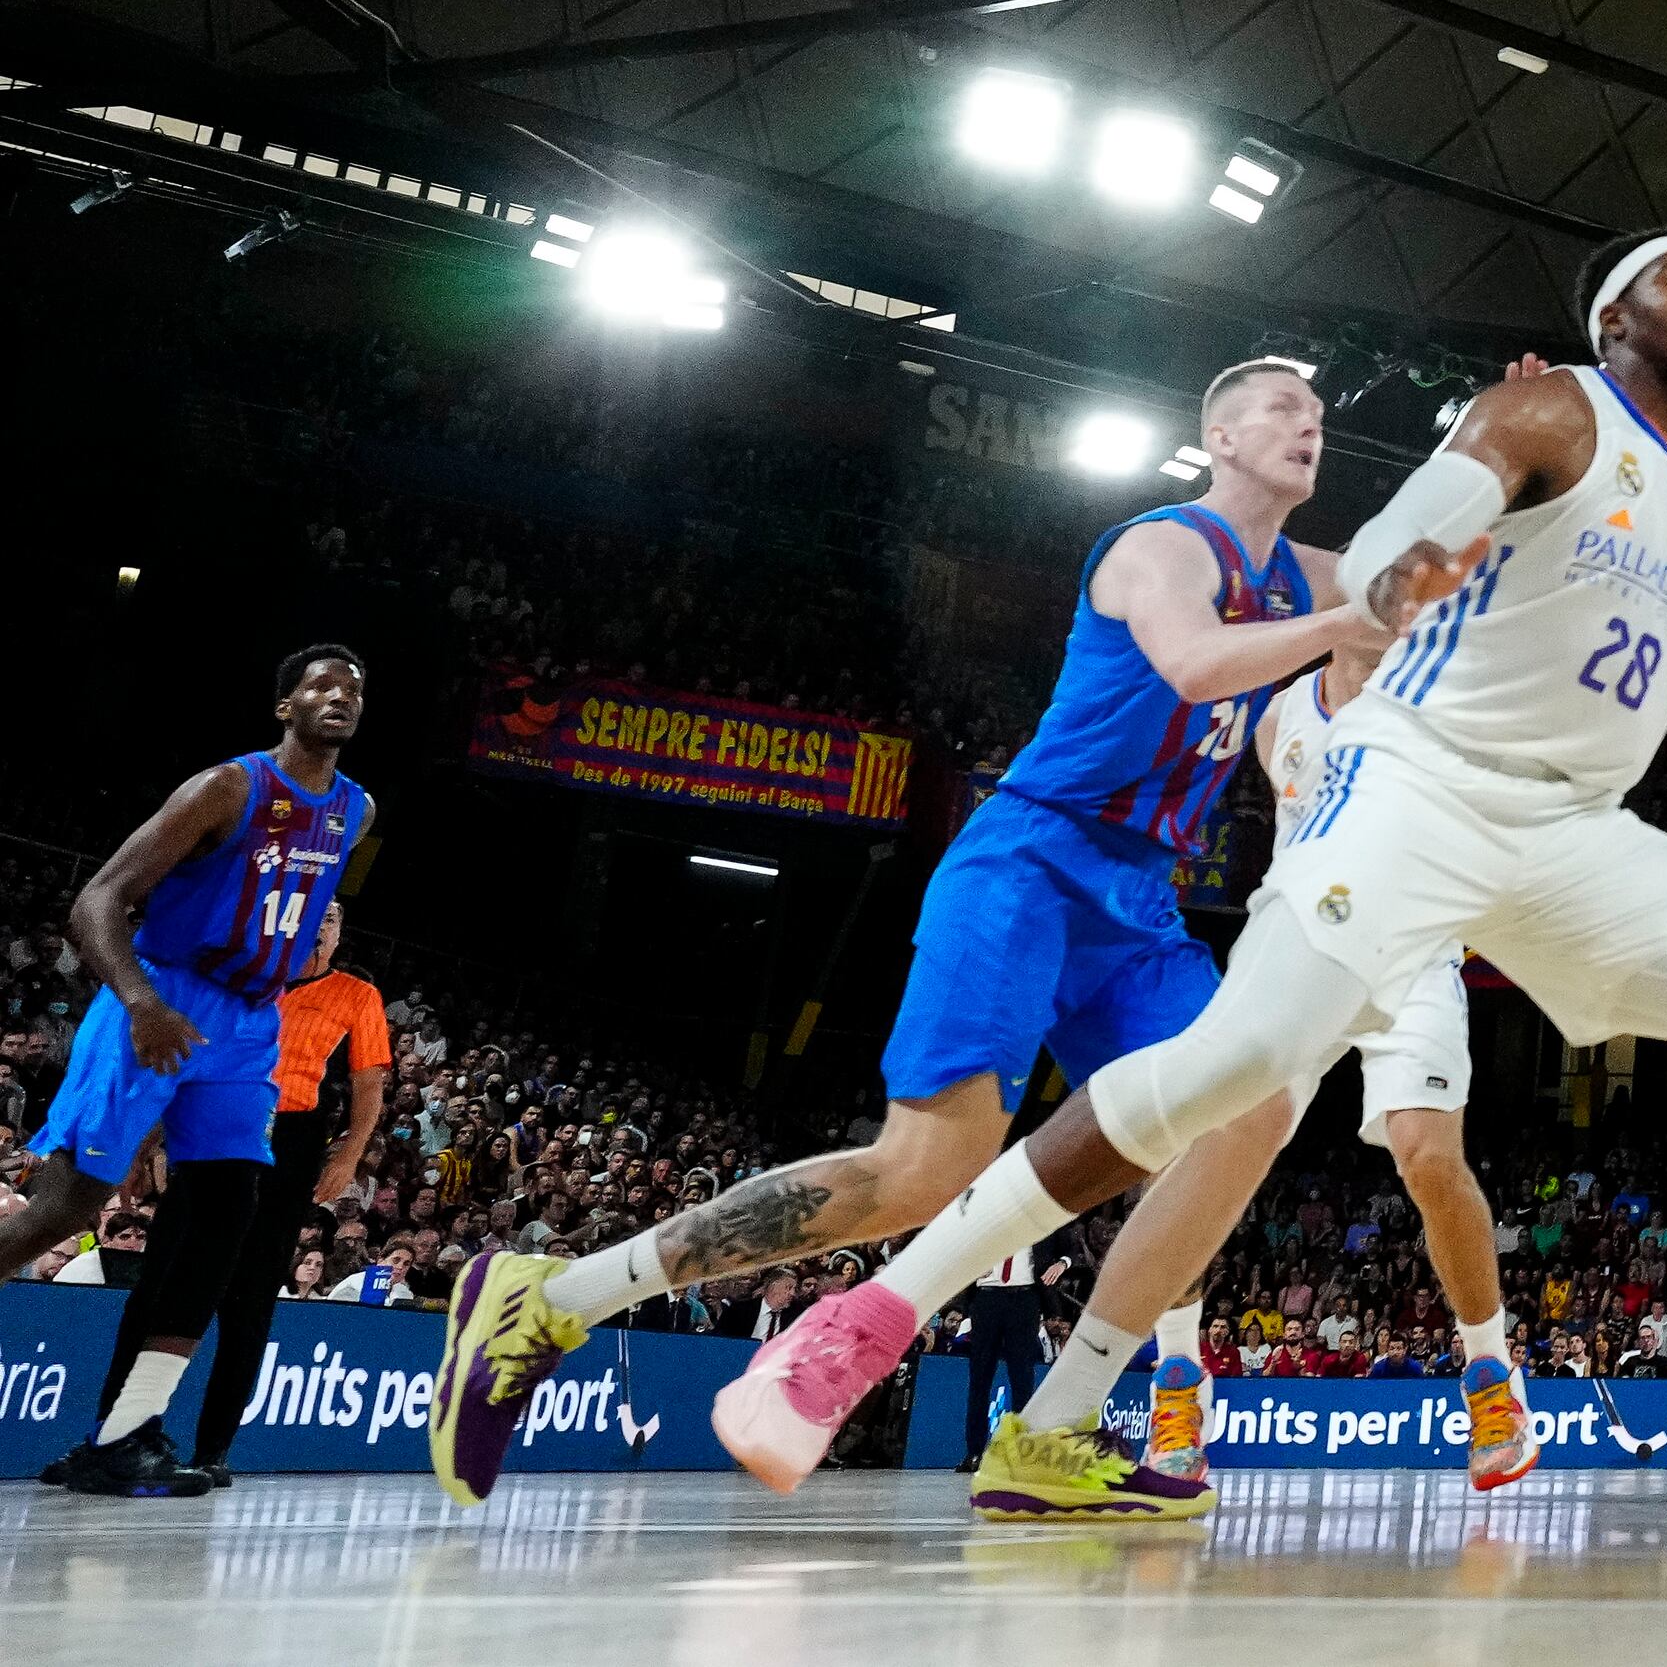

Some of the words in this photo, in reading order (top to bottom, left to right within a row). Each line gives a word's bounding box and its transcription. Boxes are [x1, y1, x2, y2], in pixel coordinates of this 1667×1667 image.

[1578, 616, 1662, 712] 28
[575, 697, 710, 762] SEMPRE
[716, 717, 833, 778] FIDELS!
[572, 760, 603, 784] Des
[608, 765, 632, 787] de
[637, 770, 686, 796] 1997
[757, 782, 775, 807] al
[778, 789, 825, 817] Barça
[263, 890, 307, 939] 14
[367, 1368, 431, 1445] pe
[1326, 1408, 1411, 1454] per
[1419, 1397, 1599, 1446] l'eort
